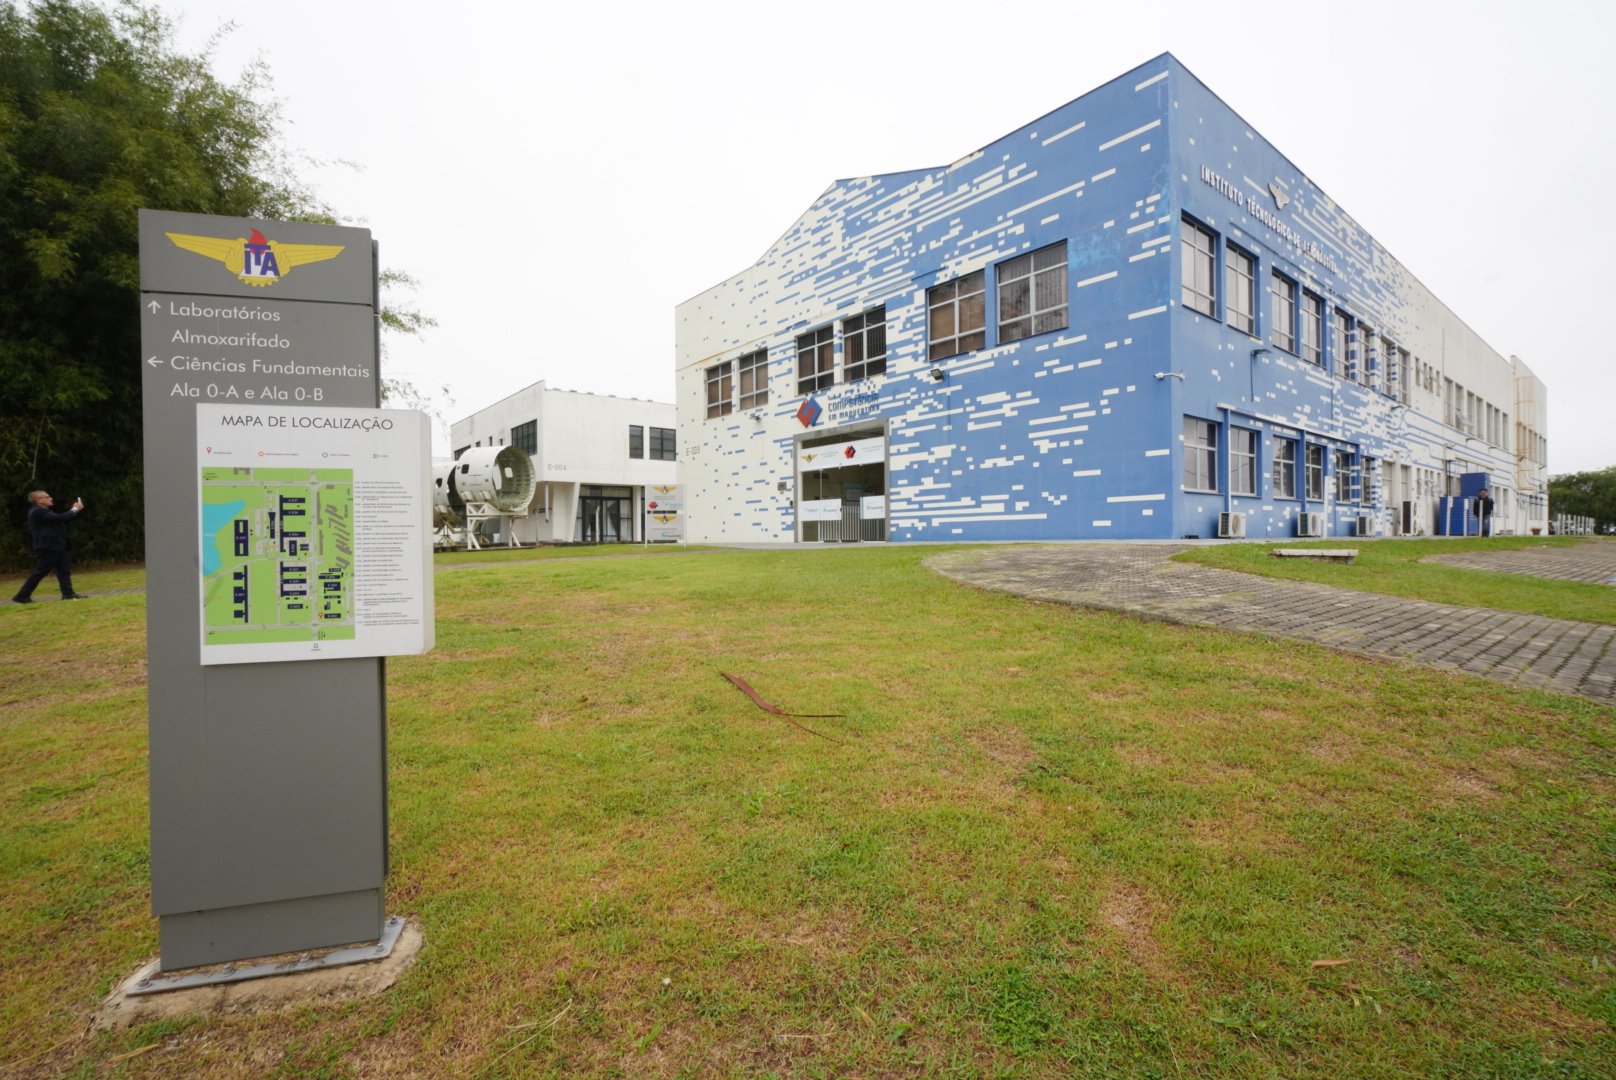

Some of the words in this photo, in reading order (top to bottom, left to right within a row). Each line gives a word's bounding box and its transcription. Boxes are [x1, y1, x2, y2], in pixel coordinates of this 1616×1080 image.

[1201, 164, 1243, 207] INSTITUTO
[244, 243, 280, 277] ITA
[170, 301, 281, 322] Laboratórios
[171, 329, 290, 349] Almoxarifado
[170, 355, 246, 373] Ciências
[252, 359, 370, 378] Fundamentais
[170, 383, 200, 398] Ala
[244, 388, 255, 400] e
[260, 385, 289, 401] Ala
[221, 415, 263, 427] MAPA
[268, 416, 287, 427] DE
[292, 416, 394, 432] LOCALIZAÇÃO
